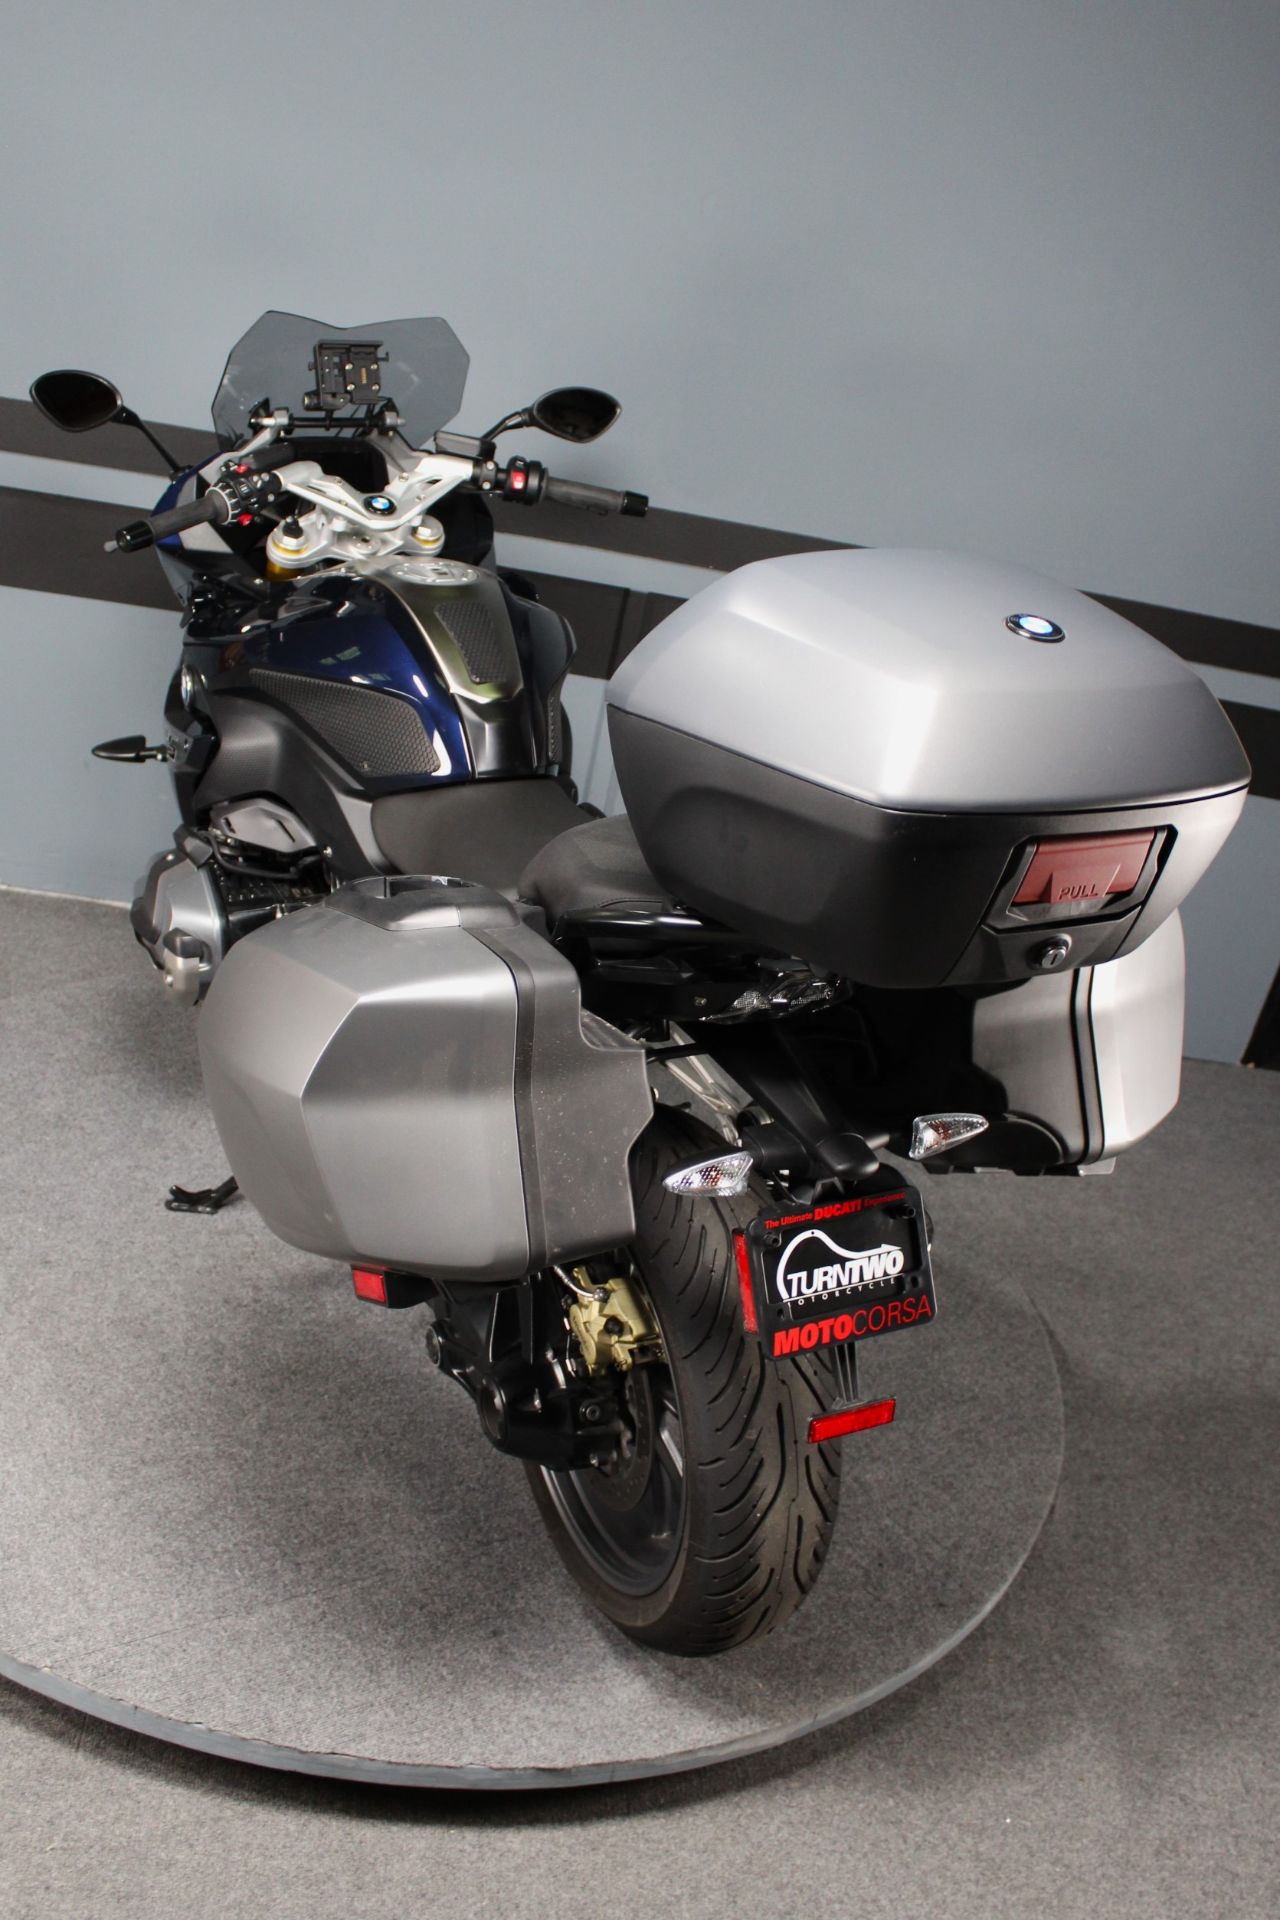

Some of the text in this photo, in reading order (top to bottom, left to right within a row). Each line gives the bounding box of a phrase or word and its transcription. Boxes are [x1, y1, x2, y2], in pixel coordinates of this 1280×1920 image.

[1058, 883, 1099, 900] PULL
[765, 1220, 780, 1230] The
[781, 1212, 812, 1226] Ultimate
[813, 1200, 862, 1221] DUCATI
[788, 1278, 896, 1306] OTORCYCLE
[773, 1295, 932, 1357] MOTOCORSA
